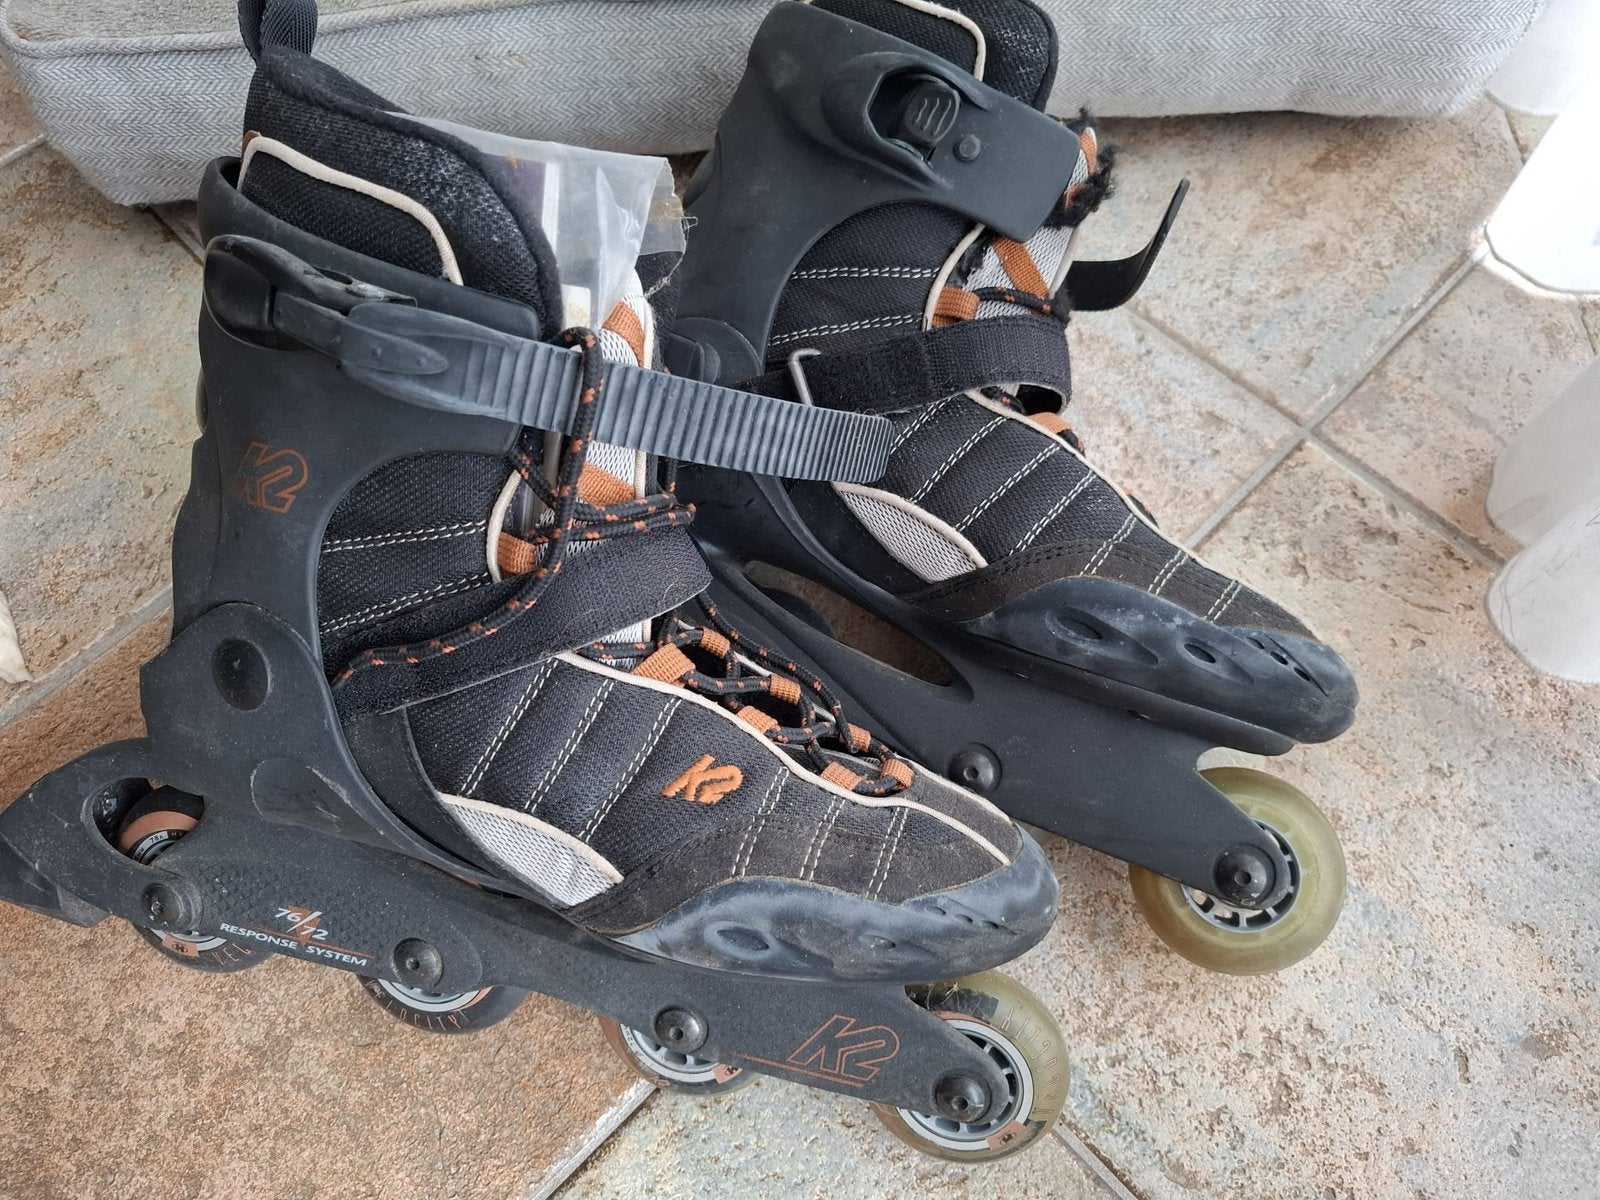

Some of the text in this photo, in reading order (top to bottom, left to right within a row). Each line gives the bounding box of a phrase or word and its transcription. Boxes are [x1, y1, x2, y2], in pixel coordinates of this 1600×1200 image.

[231, 440, 309, 514] K2
[661, 753, 744, 805] K2
[220, 923, 368, 967] RESPONSE SYSTEM
[275, 907, 329, 941] 76/72
[786, 1014, 900, 1082] K2
